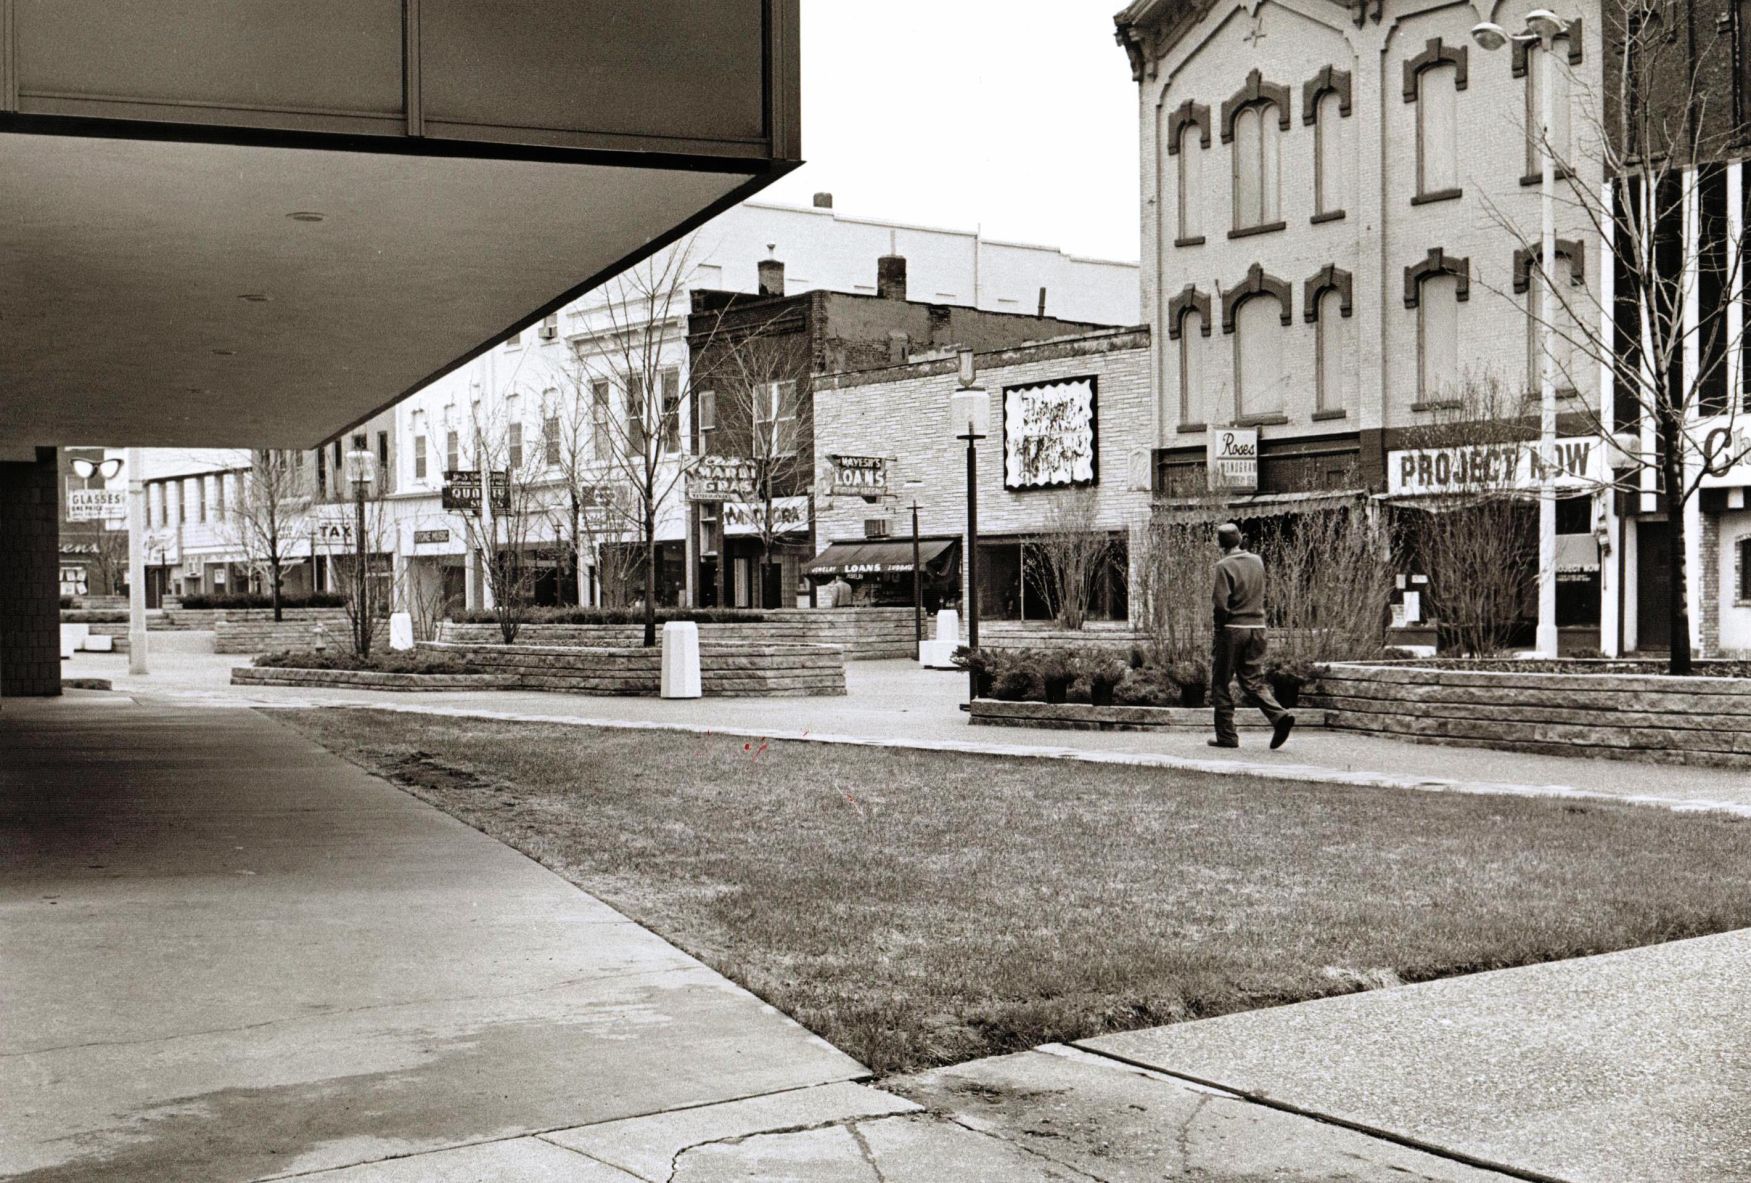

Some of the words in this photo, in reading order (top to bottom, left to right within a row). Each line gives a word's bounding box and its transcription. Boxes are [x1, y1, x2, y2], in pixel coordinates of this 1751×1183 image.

[1221, 432, 1255, 456] Roses
[1401, 446, 1516, 487] PROJECT
[1530, 442, 1590, 480] NOW
[699, 465, 757, 479] MARDI
[834, 469, 885, 488] LOANS
[703, 479, 754, 492] GRAS
[72, 493, 121, 505] GLASSES
[319, 526, 352, 538] TAX
[844, 563, 881, 573] LOANS
